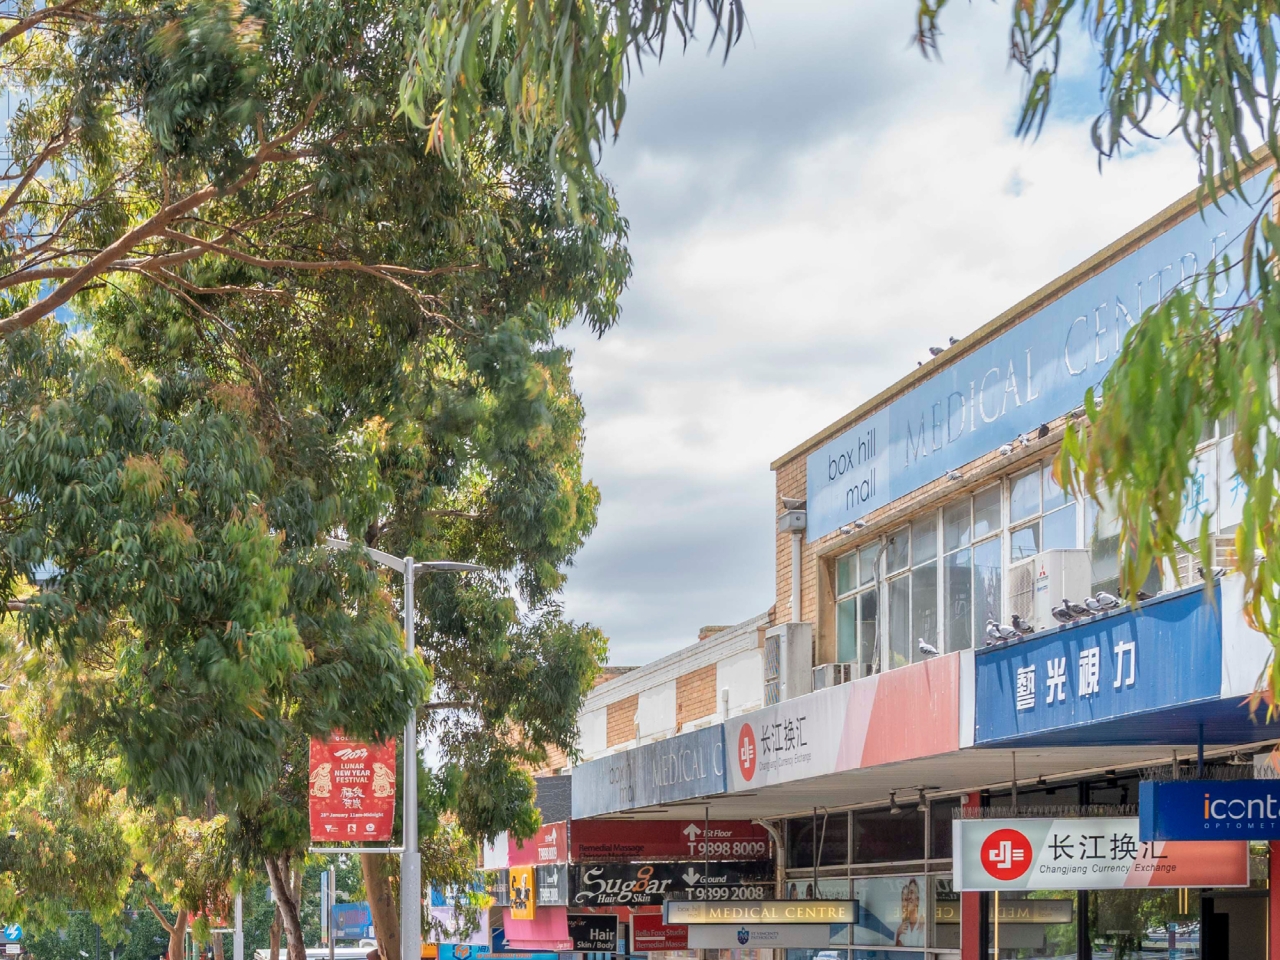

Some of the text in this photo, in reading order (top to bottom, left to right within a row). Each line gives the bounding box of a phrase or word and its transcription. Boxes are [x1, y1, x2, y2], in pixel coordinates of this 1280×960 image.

[905, 346, 1040, 469] MEDICAL
[828, 428, 876, 482] box hill
[846, 468, 876, 511] mall
[1016, 640, 1135, 710] 藝光視力
[761, 716, 807, 756] 长江换汇
[652, 750, 706, 787] MEDICAL
[759, 753, 811, 772] Changjiang Currency Exchange
[613, 844, 645, 852] Massage
[688, 842, 766, 855] T 9898 8009
[1048, 833, 1168, 861] 长江换汇
[1039, 863, 1177, 876] Changjiang Currency Exchange
[699, 875, 727, 883] Gound
[597, 894, 651, 903] Hair Skin
[686, 888, 694, 900] T
[731, 887, 764, 900] 2008
[709, 907, 845, 918] MEDICAL CENTRE
[590, 929, 615, 940] Hair
[597, 942, 614, 950] Body
[636, 941, 664, 949] Remedial
